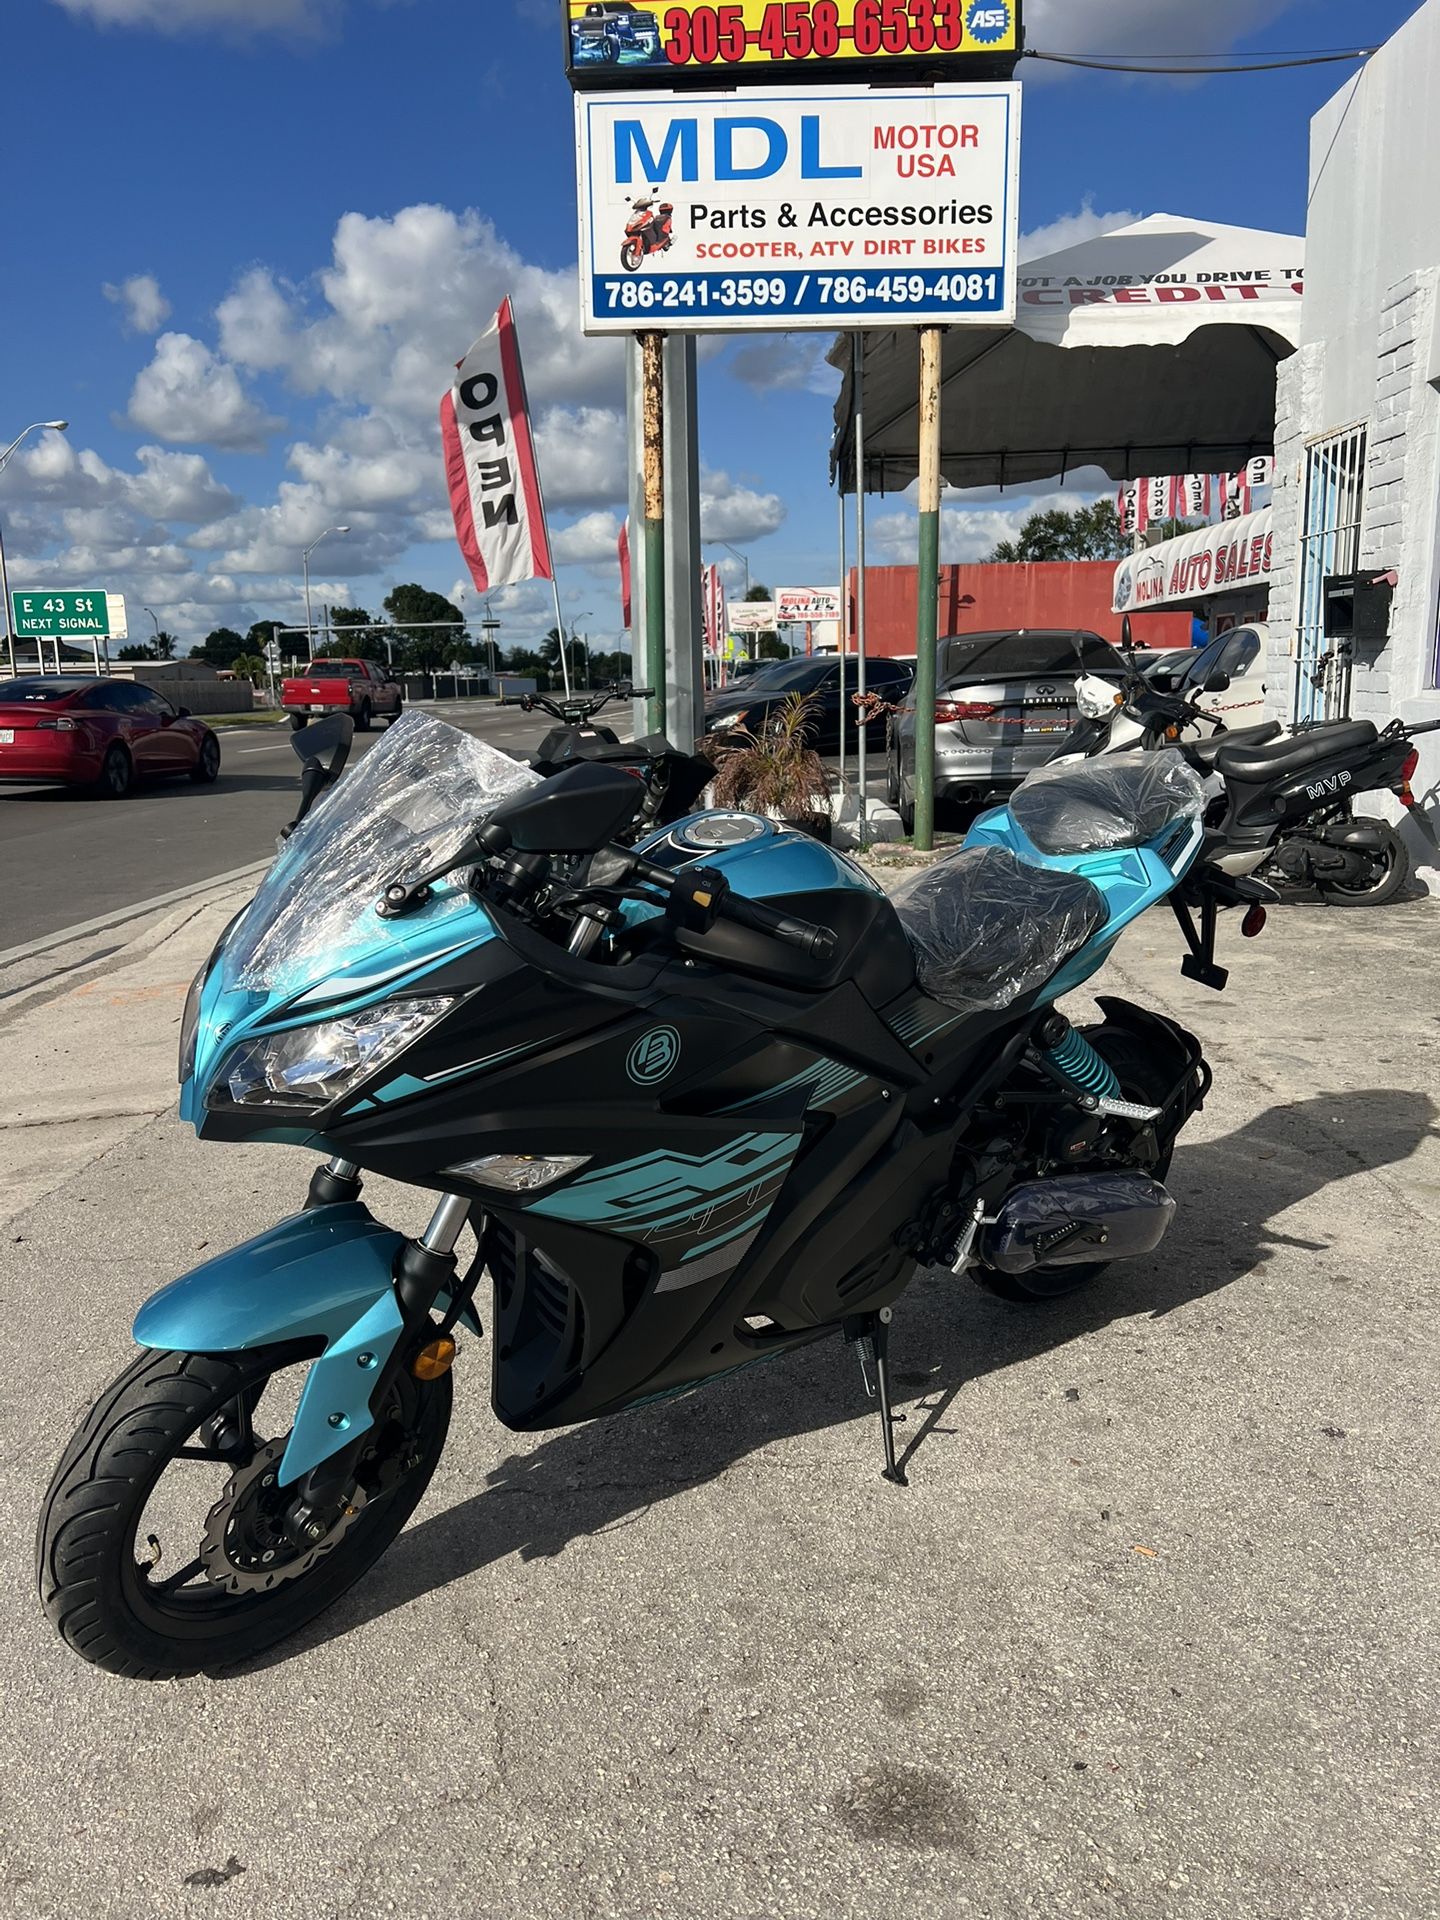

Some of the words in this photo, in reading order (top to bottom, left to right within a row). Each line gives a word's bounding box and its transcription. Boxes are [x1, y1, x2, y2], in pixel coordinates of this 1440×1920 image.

[971, 10, 1005, 28] ASE
[664, 0, 963, 65] 305-458-6533
[873, 124, 979, 150] MOTOR
[613, 115, 863, 184] MDL
[896, 153, 956, 178] USA
[690, 203, 766, 229] Parts
[777, 203, 798, 228] &
[808, 199, 993, 227] Accessories
[696, 241, 804, 260] SCOOTER,
[810, 240, 855, 257] ATV
[864, 239, 916, 256] DIRT
[923, 238, 986, 254] BIKES
[1063, 276, 1083, 287] A
[1086, 275, 1134, 286] JOB
[1139, 273, 1187, 285] YOU
[1197, 270, 1272, 283] DRIVE
[605, 277, 787, 308] 786-241-3599
[794, 276, 810, 306] /
[817, 273, 997, 304] 786-459-4081
[1023, 284, 1269, 305] CREDIT
[1135, 576, 1164, 602] MOLINA
[1168, 548, 1213, 596] AUTO
[23, 599, 33, 613] E
[43, 599, 65, 613] 43
[75, 598, 93, 613] St
[779, 603, 836, 612] SALES
[811, 596, 831, 604] AUTO
[22, 619, 52, 629] NEXT
[59, 617, 103, 629] SIGNAL
[1306, 770, 1351, 800] MVP
